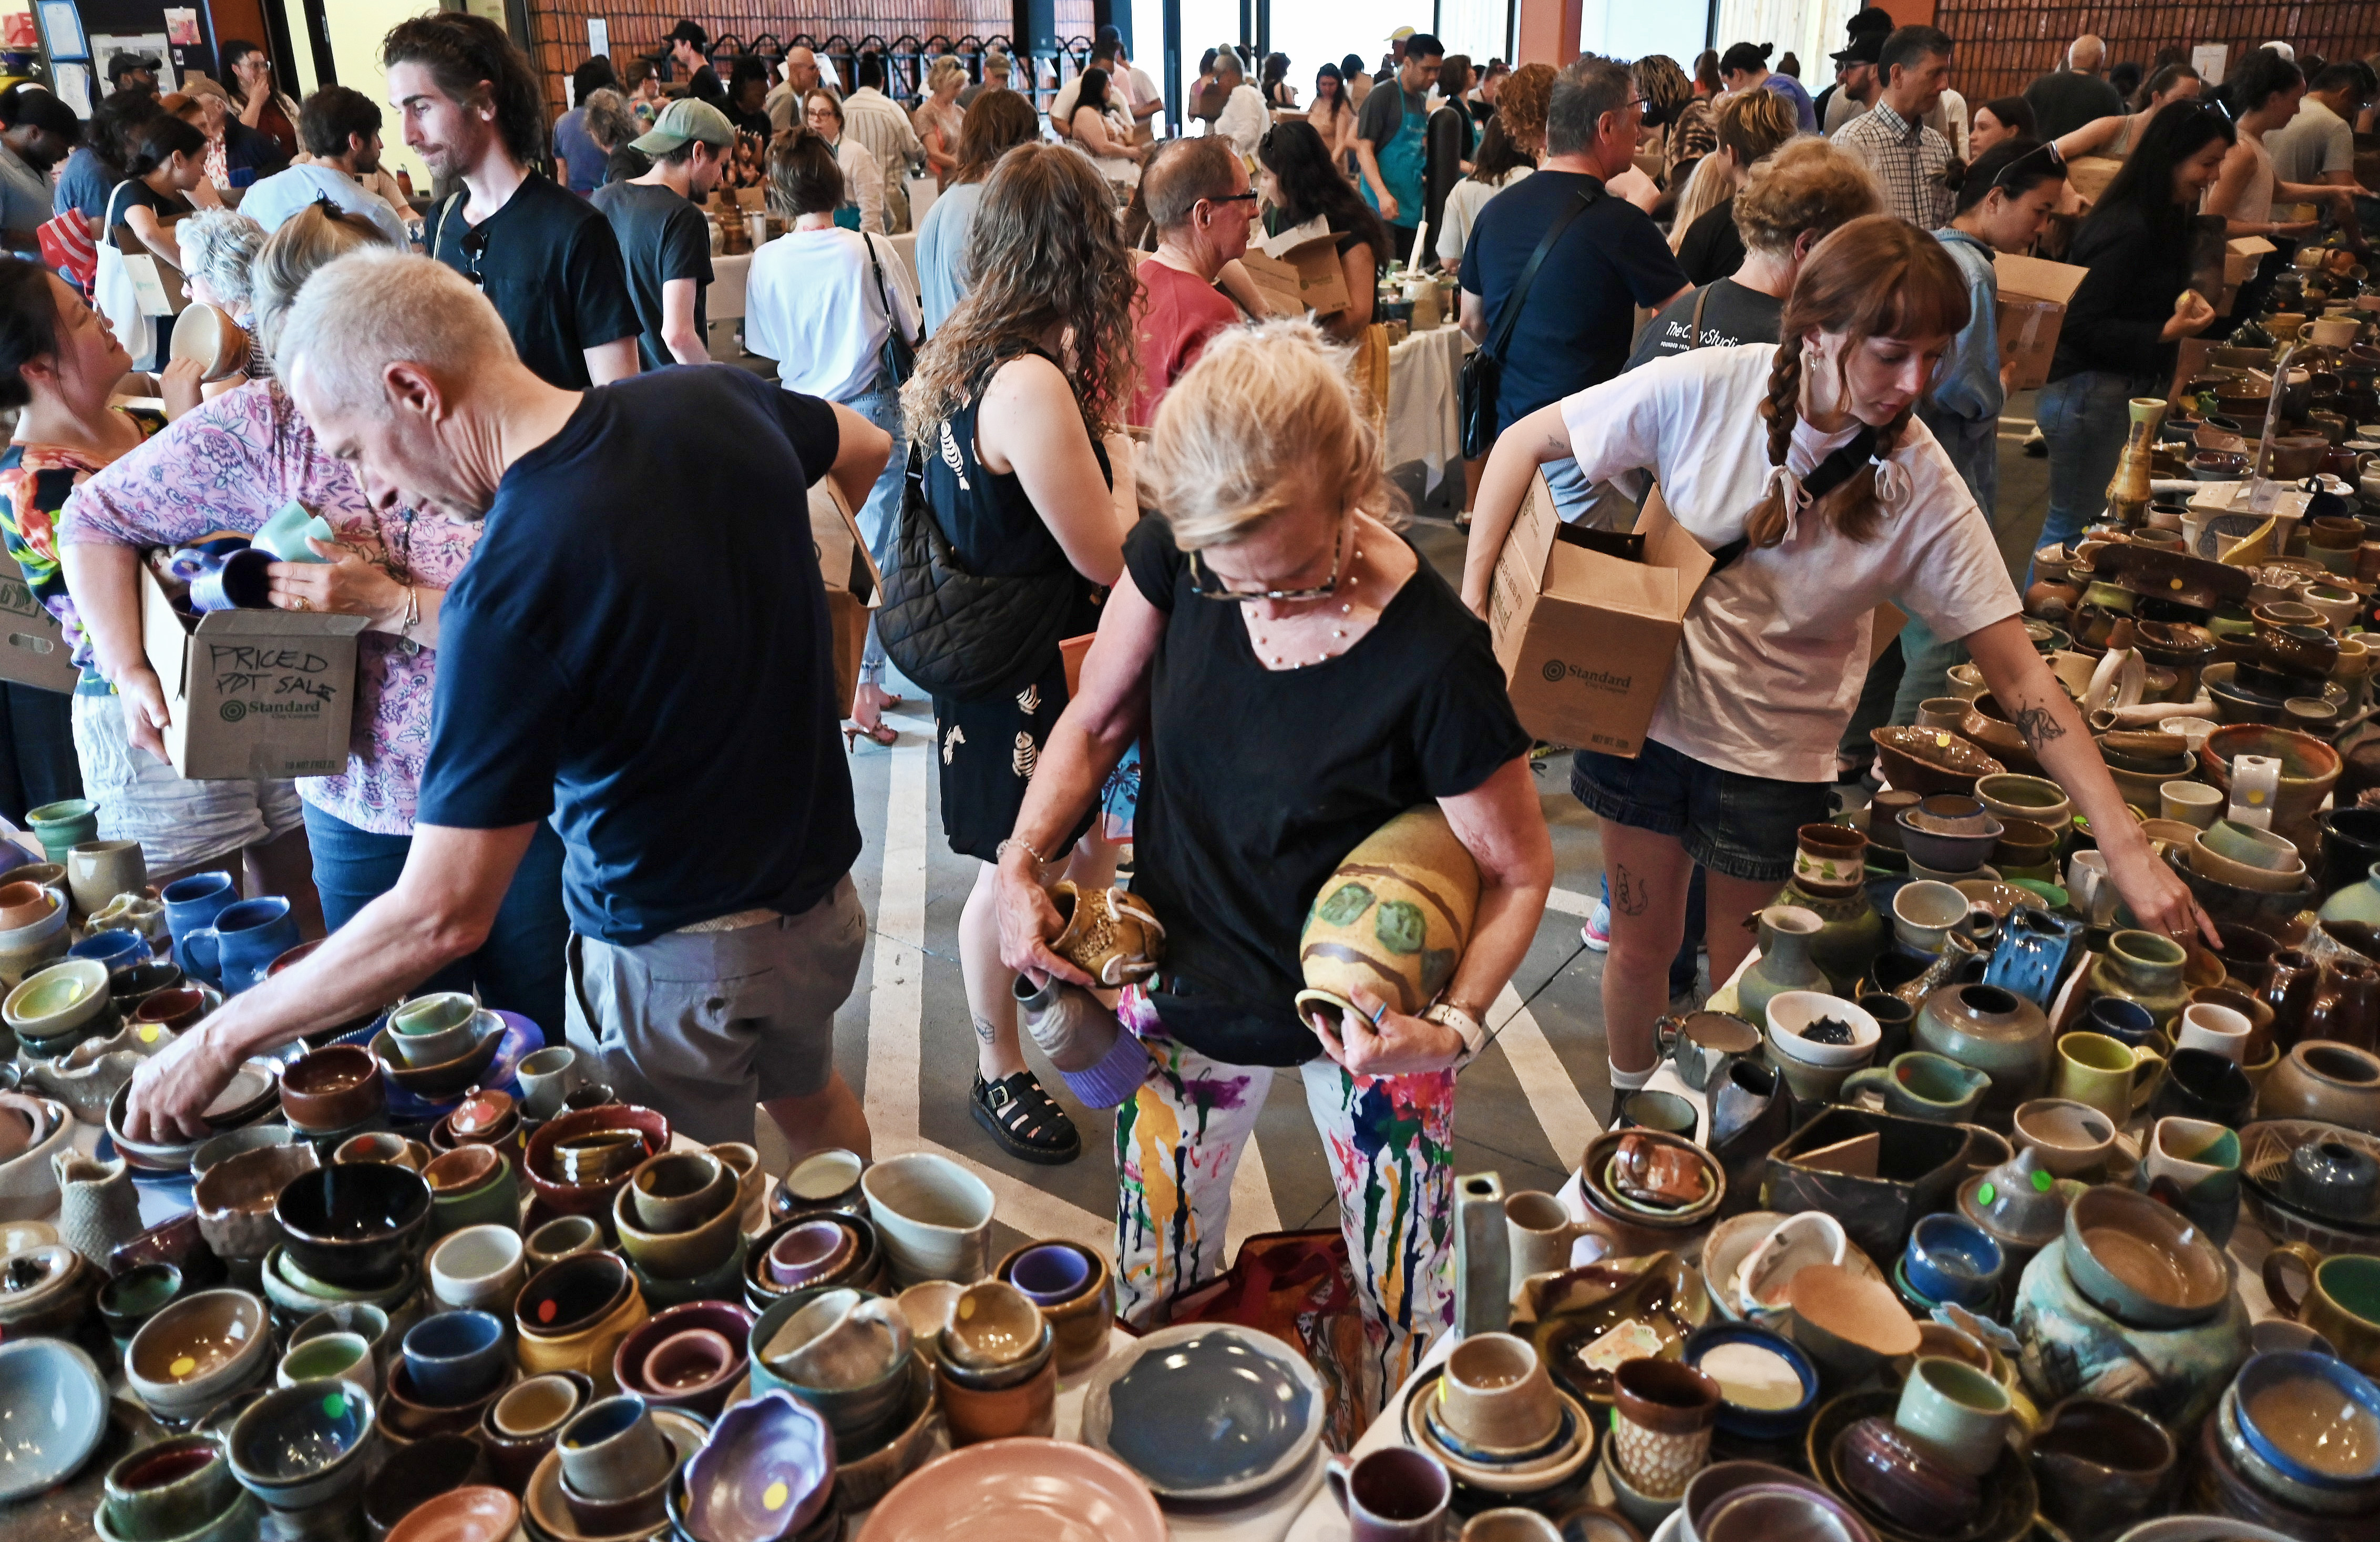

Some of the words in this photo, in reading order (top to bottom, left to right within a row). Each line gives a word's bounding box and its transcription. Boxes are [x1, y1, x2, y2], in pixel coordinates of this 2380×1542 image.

[1666, 321, 1683, 337] The
[209, 644, 328, 675] PRICED
[1568, 664, 1632, 688] Standard
[274, 676, 336, 702] SALE
[248, 700, 320, 712] Standard
